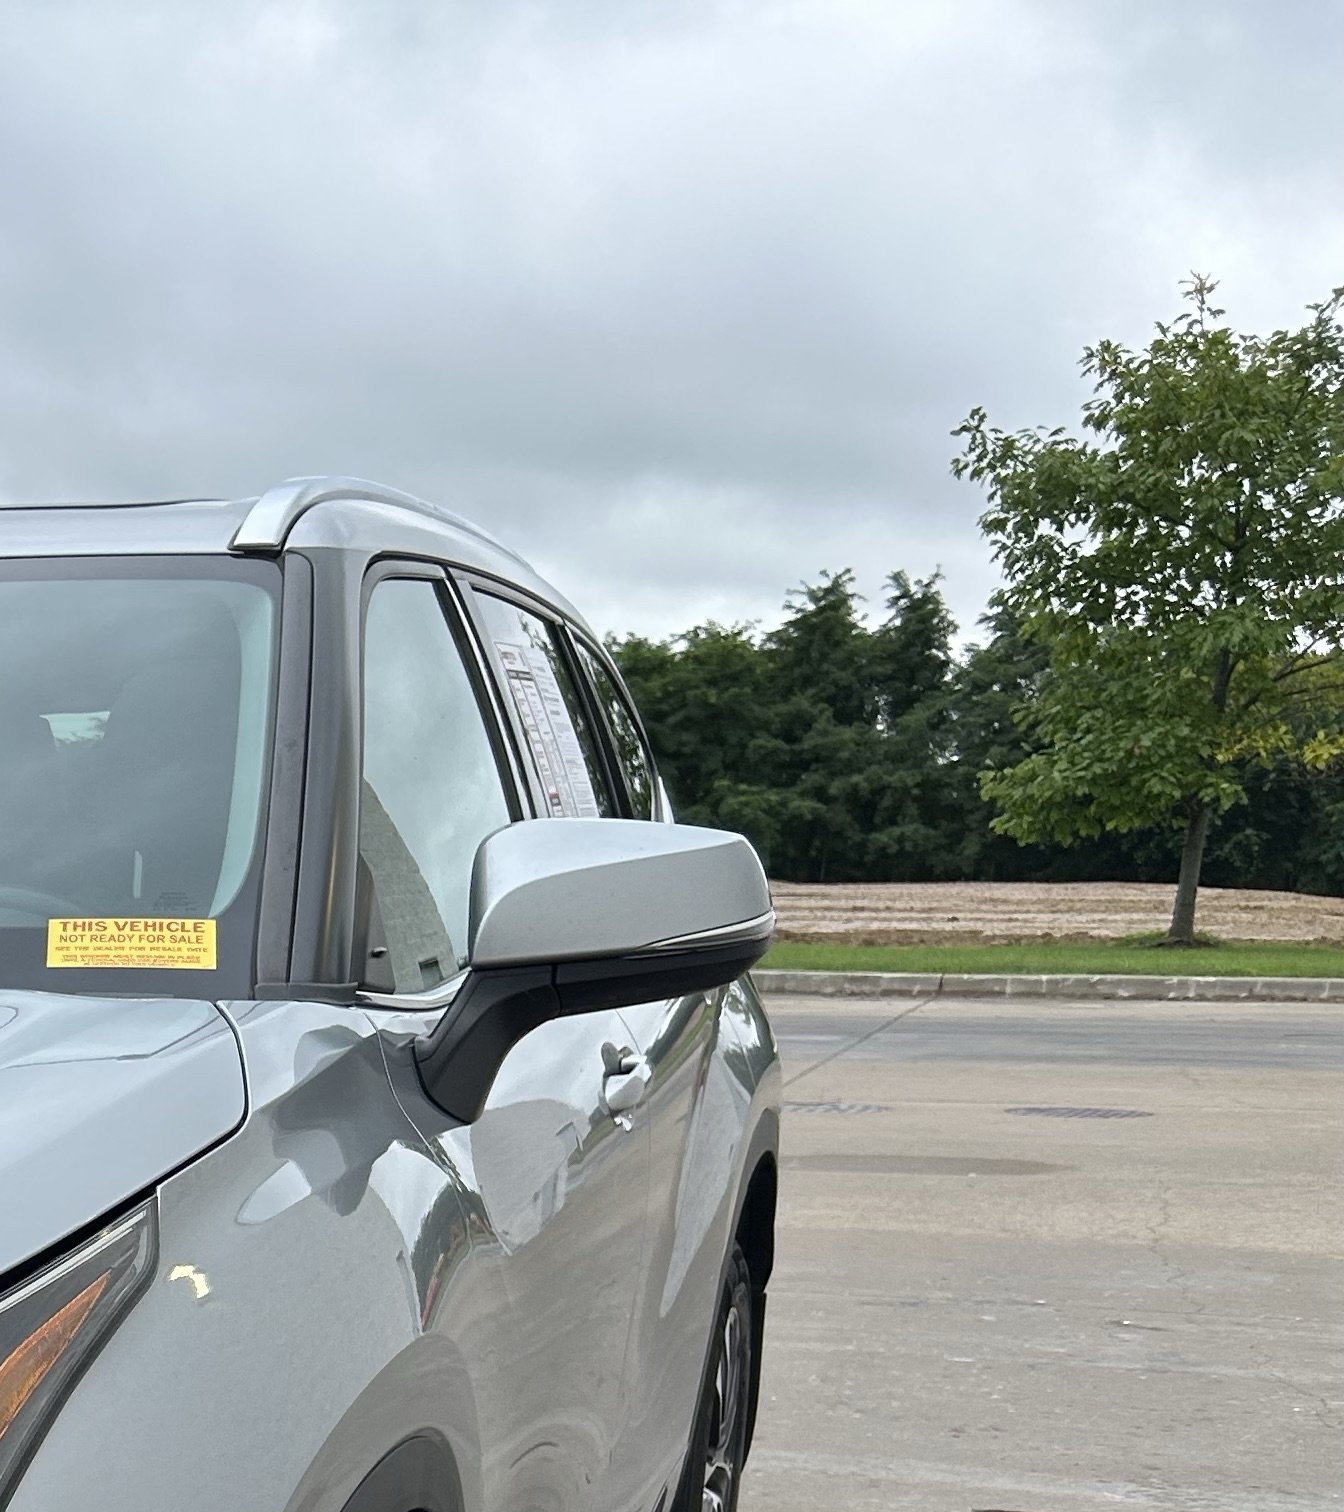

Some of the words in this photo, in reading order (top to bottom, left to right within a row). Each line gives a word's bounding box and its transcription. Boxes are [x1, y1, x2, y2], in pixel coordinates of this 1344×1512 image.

[59, 920, 108, 932] THIS
[114, 920, 206, 933] VEHICLE
[59, 934, 85, 943] NOT
[90, 934, 135, 944] READY
[139, 934, 164, 944] FOR
[169, 935, 204, 945] SALE
